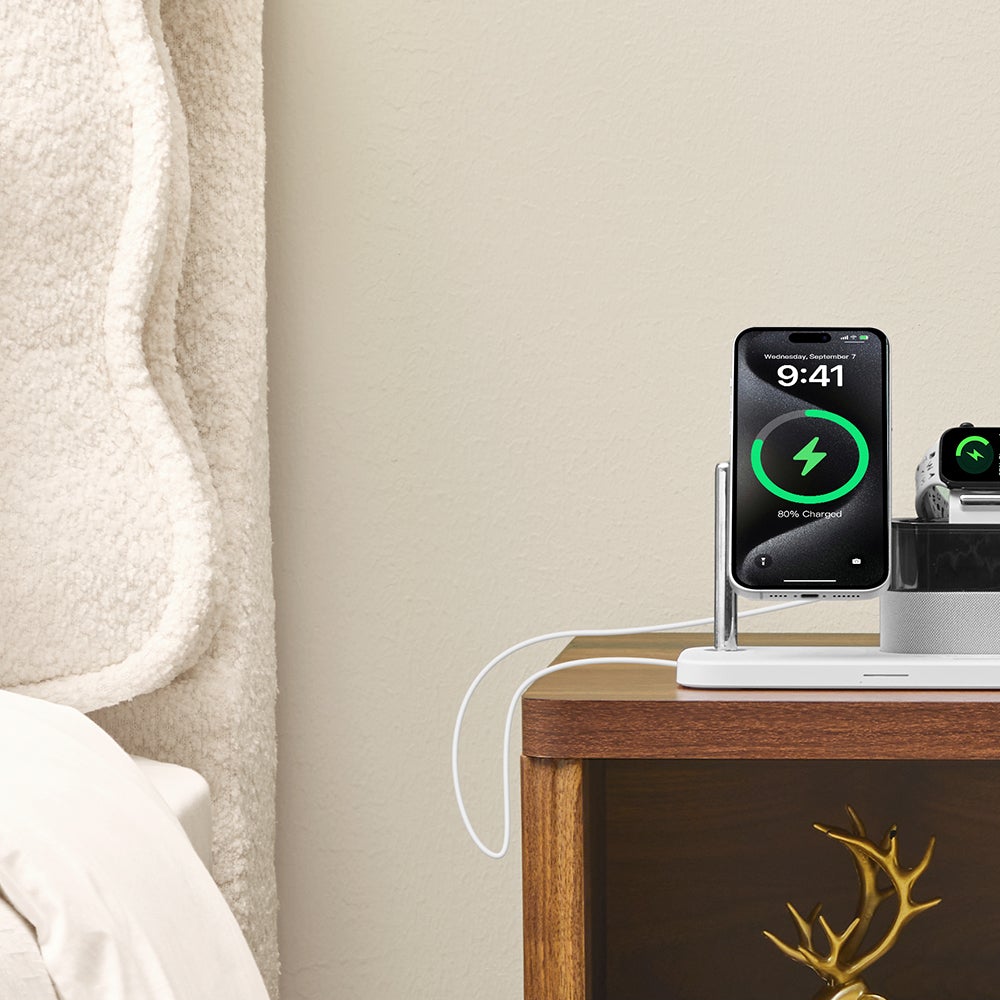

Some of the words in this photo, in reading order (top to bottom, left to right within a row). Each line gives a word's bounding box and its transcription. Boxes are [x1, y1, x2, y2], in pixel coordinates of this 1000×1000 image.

[764, 353, 808, 361] Wednesday,
[809, 353, 849, 361] September
[777, 364, 844, 387] 9:41
[777, 510, 800, 518] 80%
[802, 510, 843, 519] Charged
